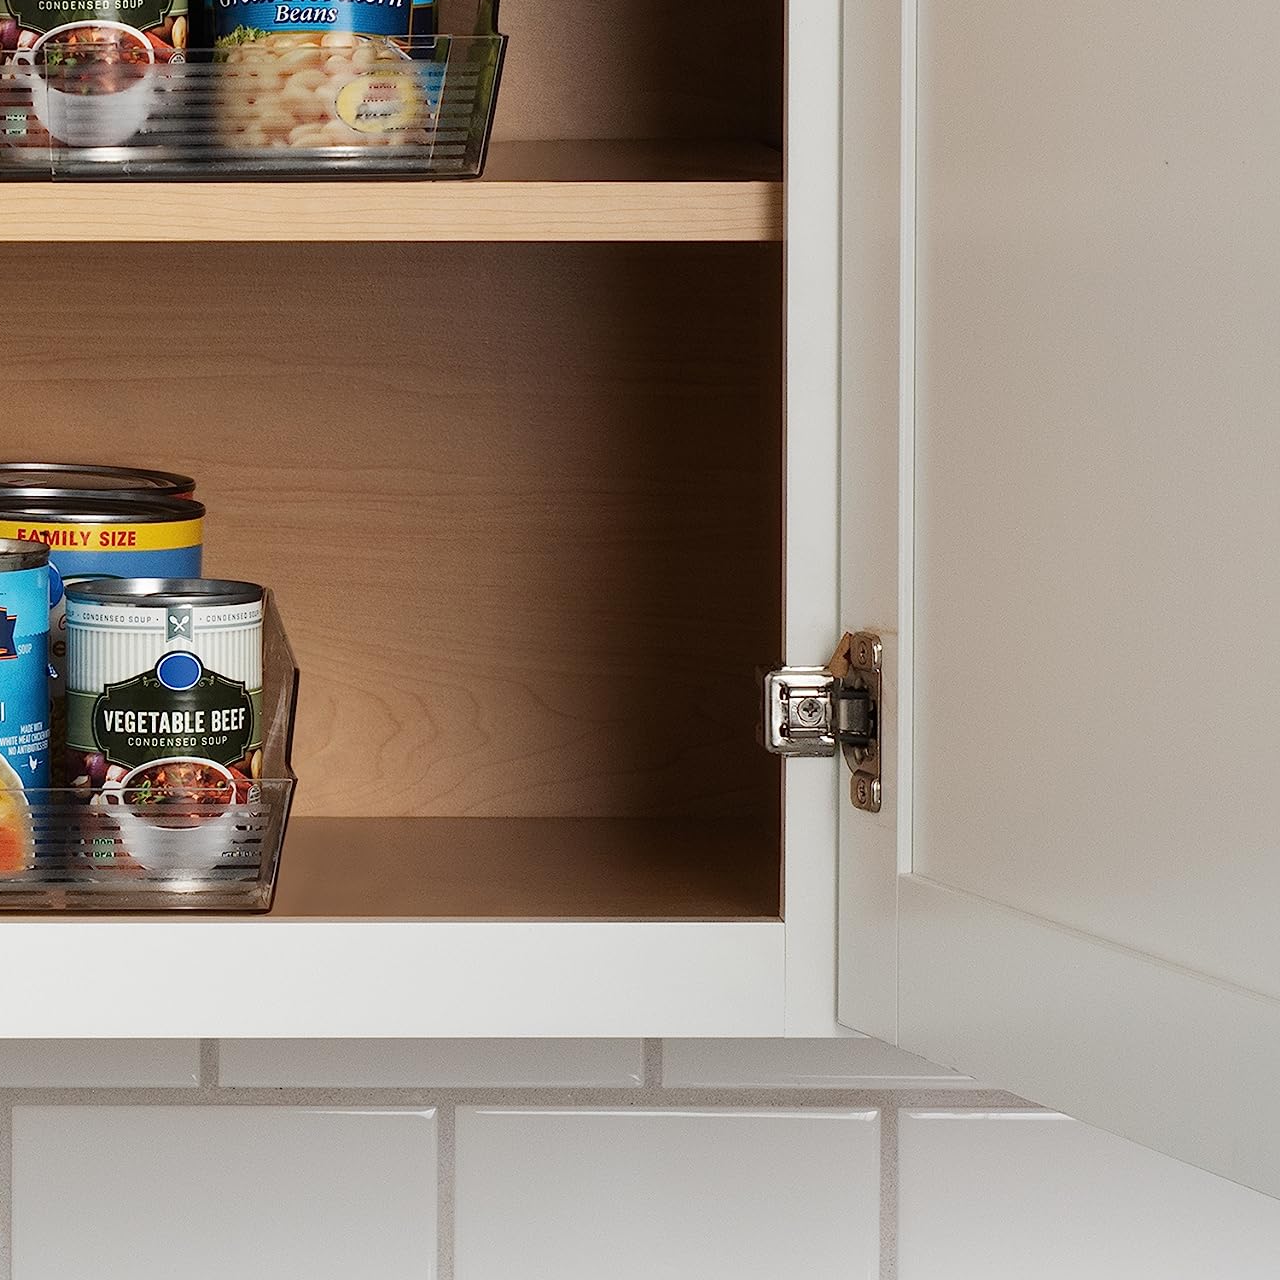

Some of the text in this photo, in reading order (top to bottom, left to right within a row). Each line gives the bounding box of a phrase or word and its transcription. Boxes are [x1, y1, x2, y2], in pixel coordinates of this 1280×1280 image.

[38, 0, 110, 10] CONDENSED
[275, 5, 338, 23] Beans
[17, 528, 136, 547] FAMILY SIZE
[128, 616, 152, 624] SOUP
[17, 643, 33, 655] SOUP
[104, 708, 246, 734] VEGETABLE BEEF
[127, 736, 228, 747] CONDENSED SOUP
